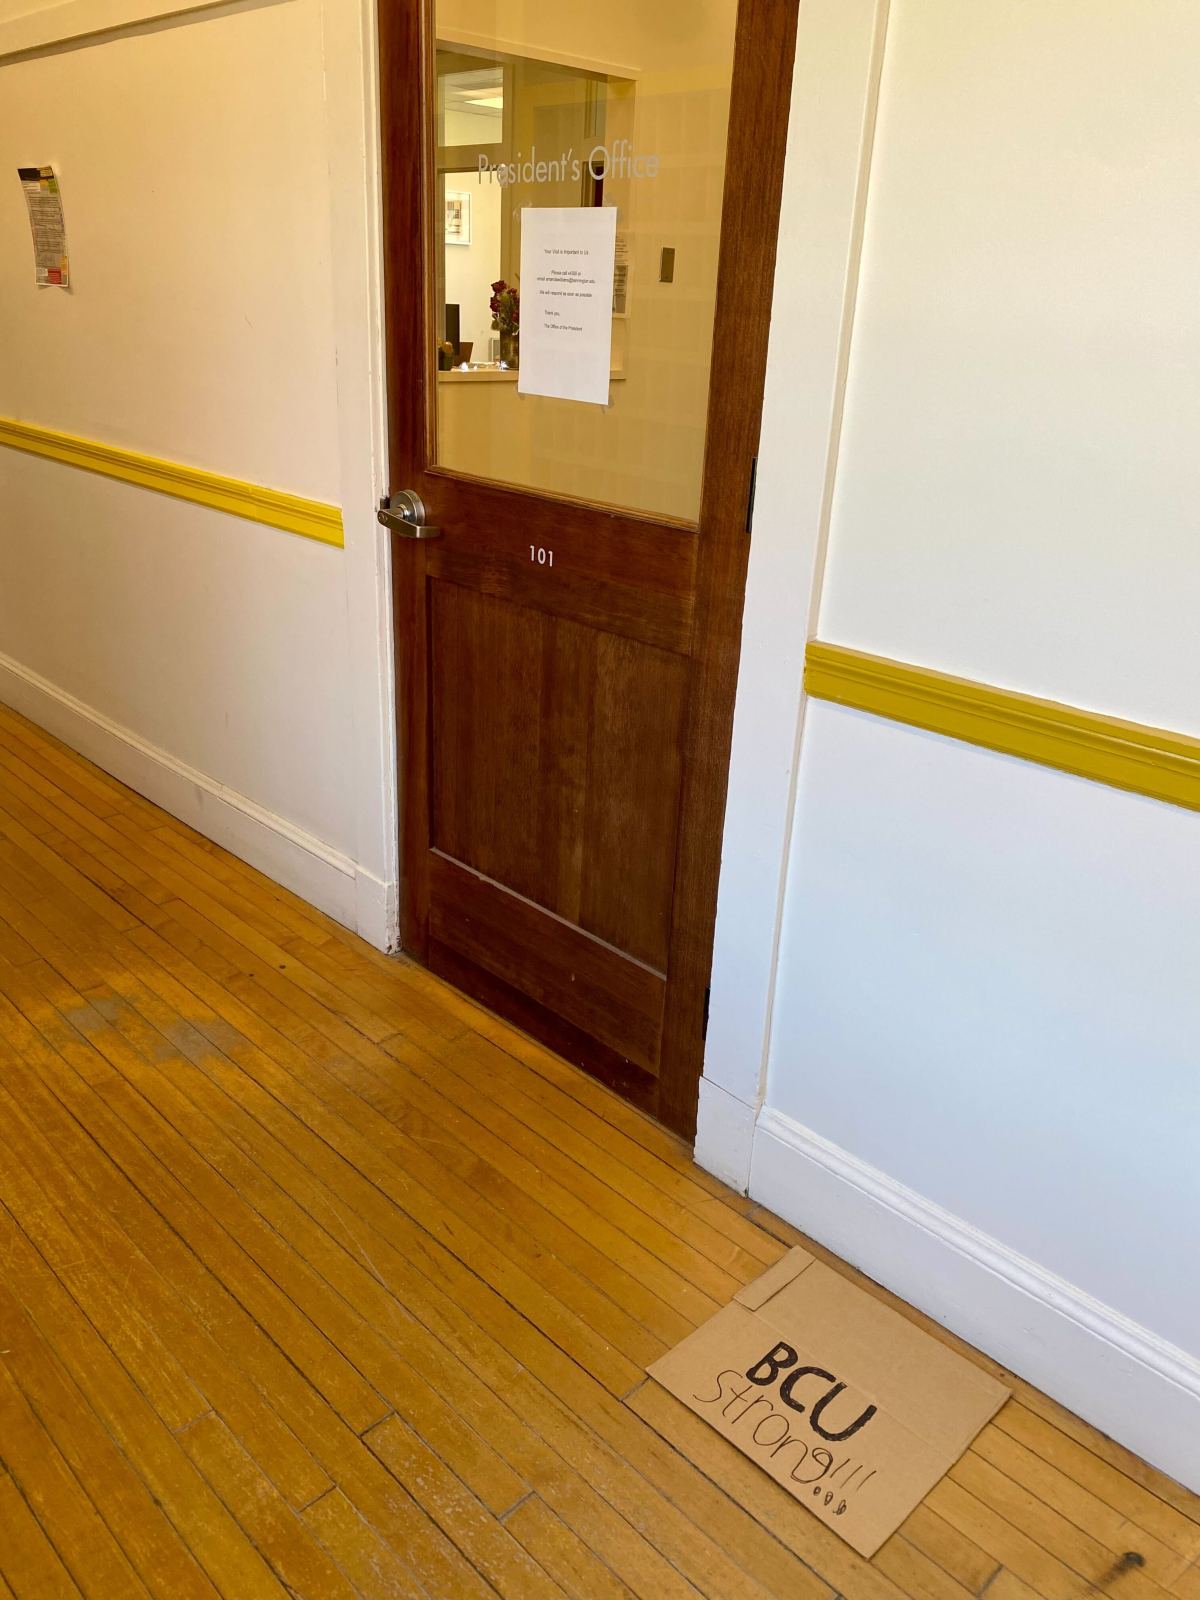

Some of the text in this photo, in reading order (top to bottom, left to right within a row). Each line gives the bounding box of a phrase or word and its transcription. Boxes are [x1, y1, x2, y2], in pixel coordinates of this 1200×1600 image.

[478, 139, 660, 186] President's Office
[530, 545, 553, 567] 101
[746, 1341, 878, 1442] BCU
